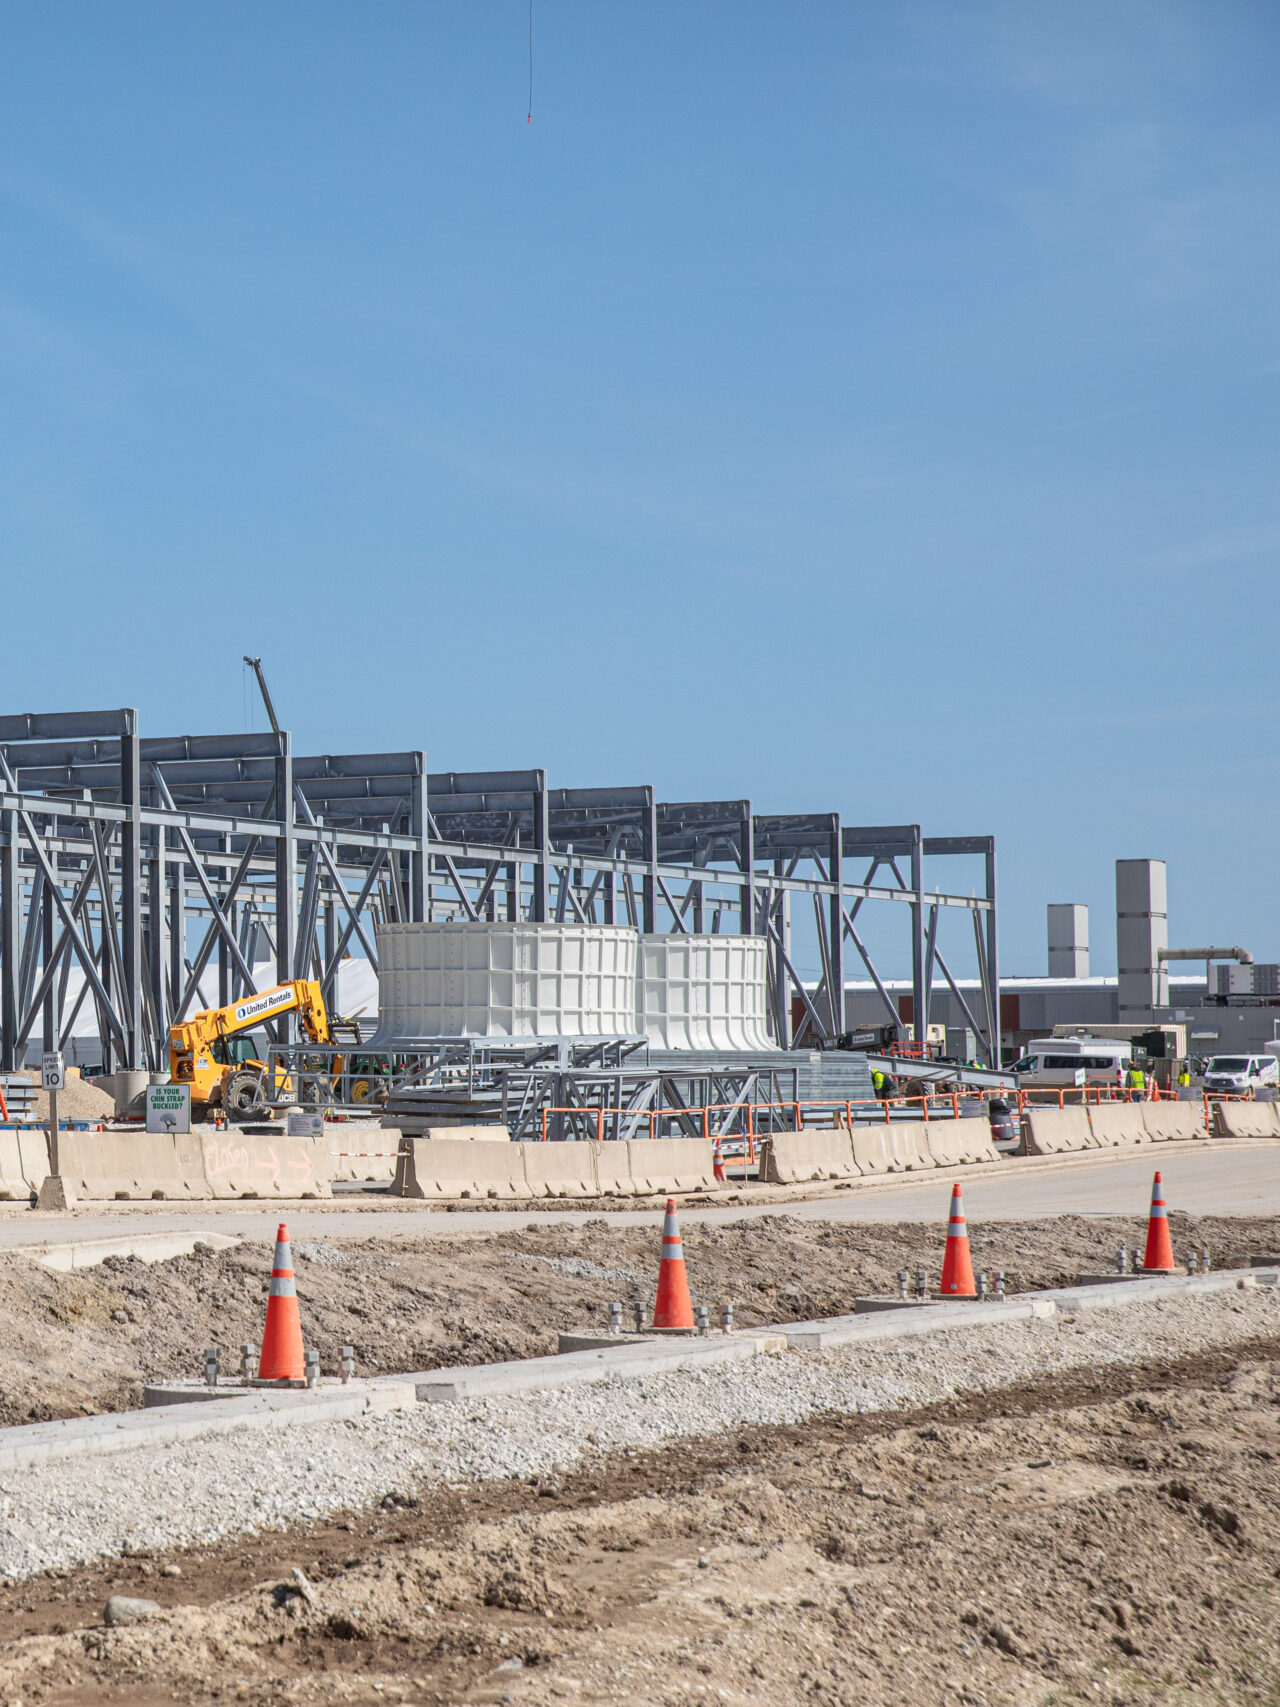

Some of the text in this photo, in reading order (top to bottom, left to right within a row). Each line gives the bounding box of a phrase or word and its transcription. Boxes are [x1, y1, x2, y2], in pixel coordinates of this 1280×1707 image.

[246, 990, 291, 1015] United Rentals
[45, 1073, 59, 1085] 10
[278, 1093, 295, 1102] JCB
